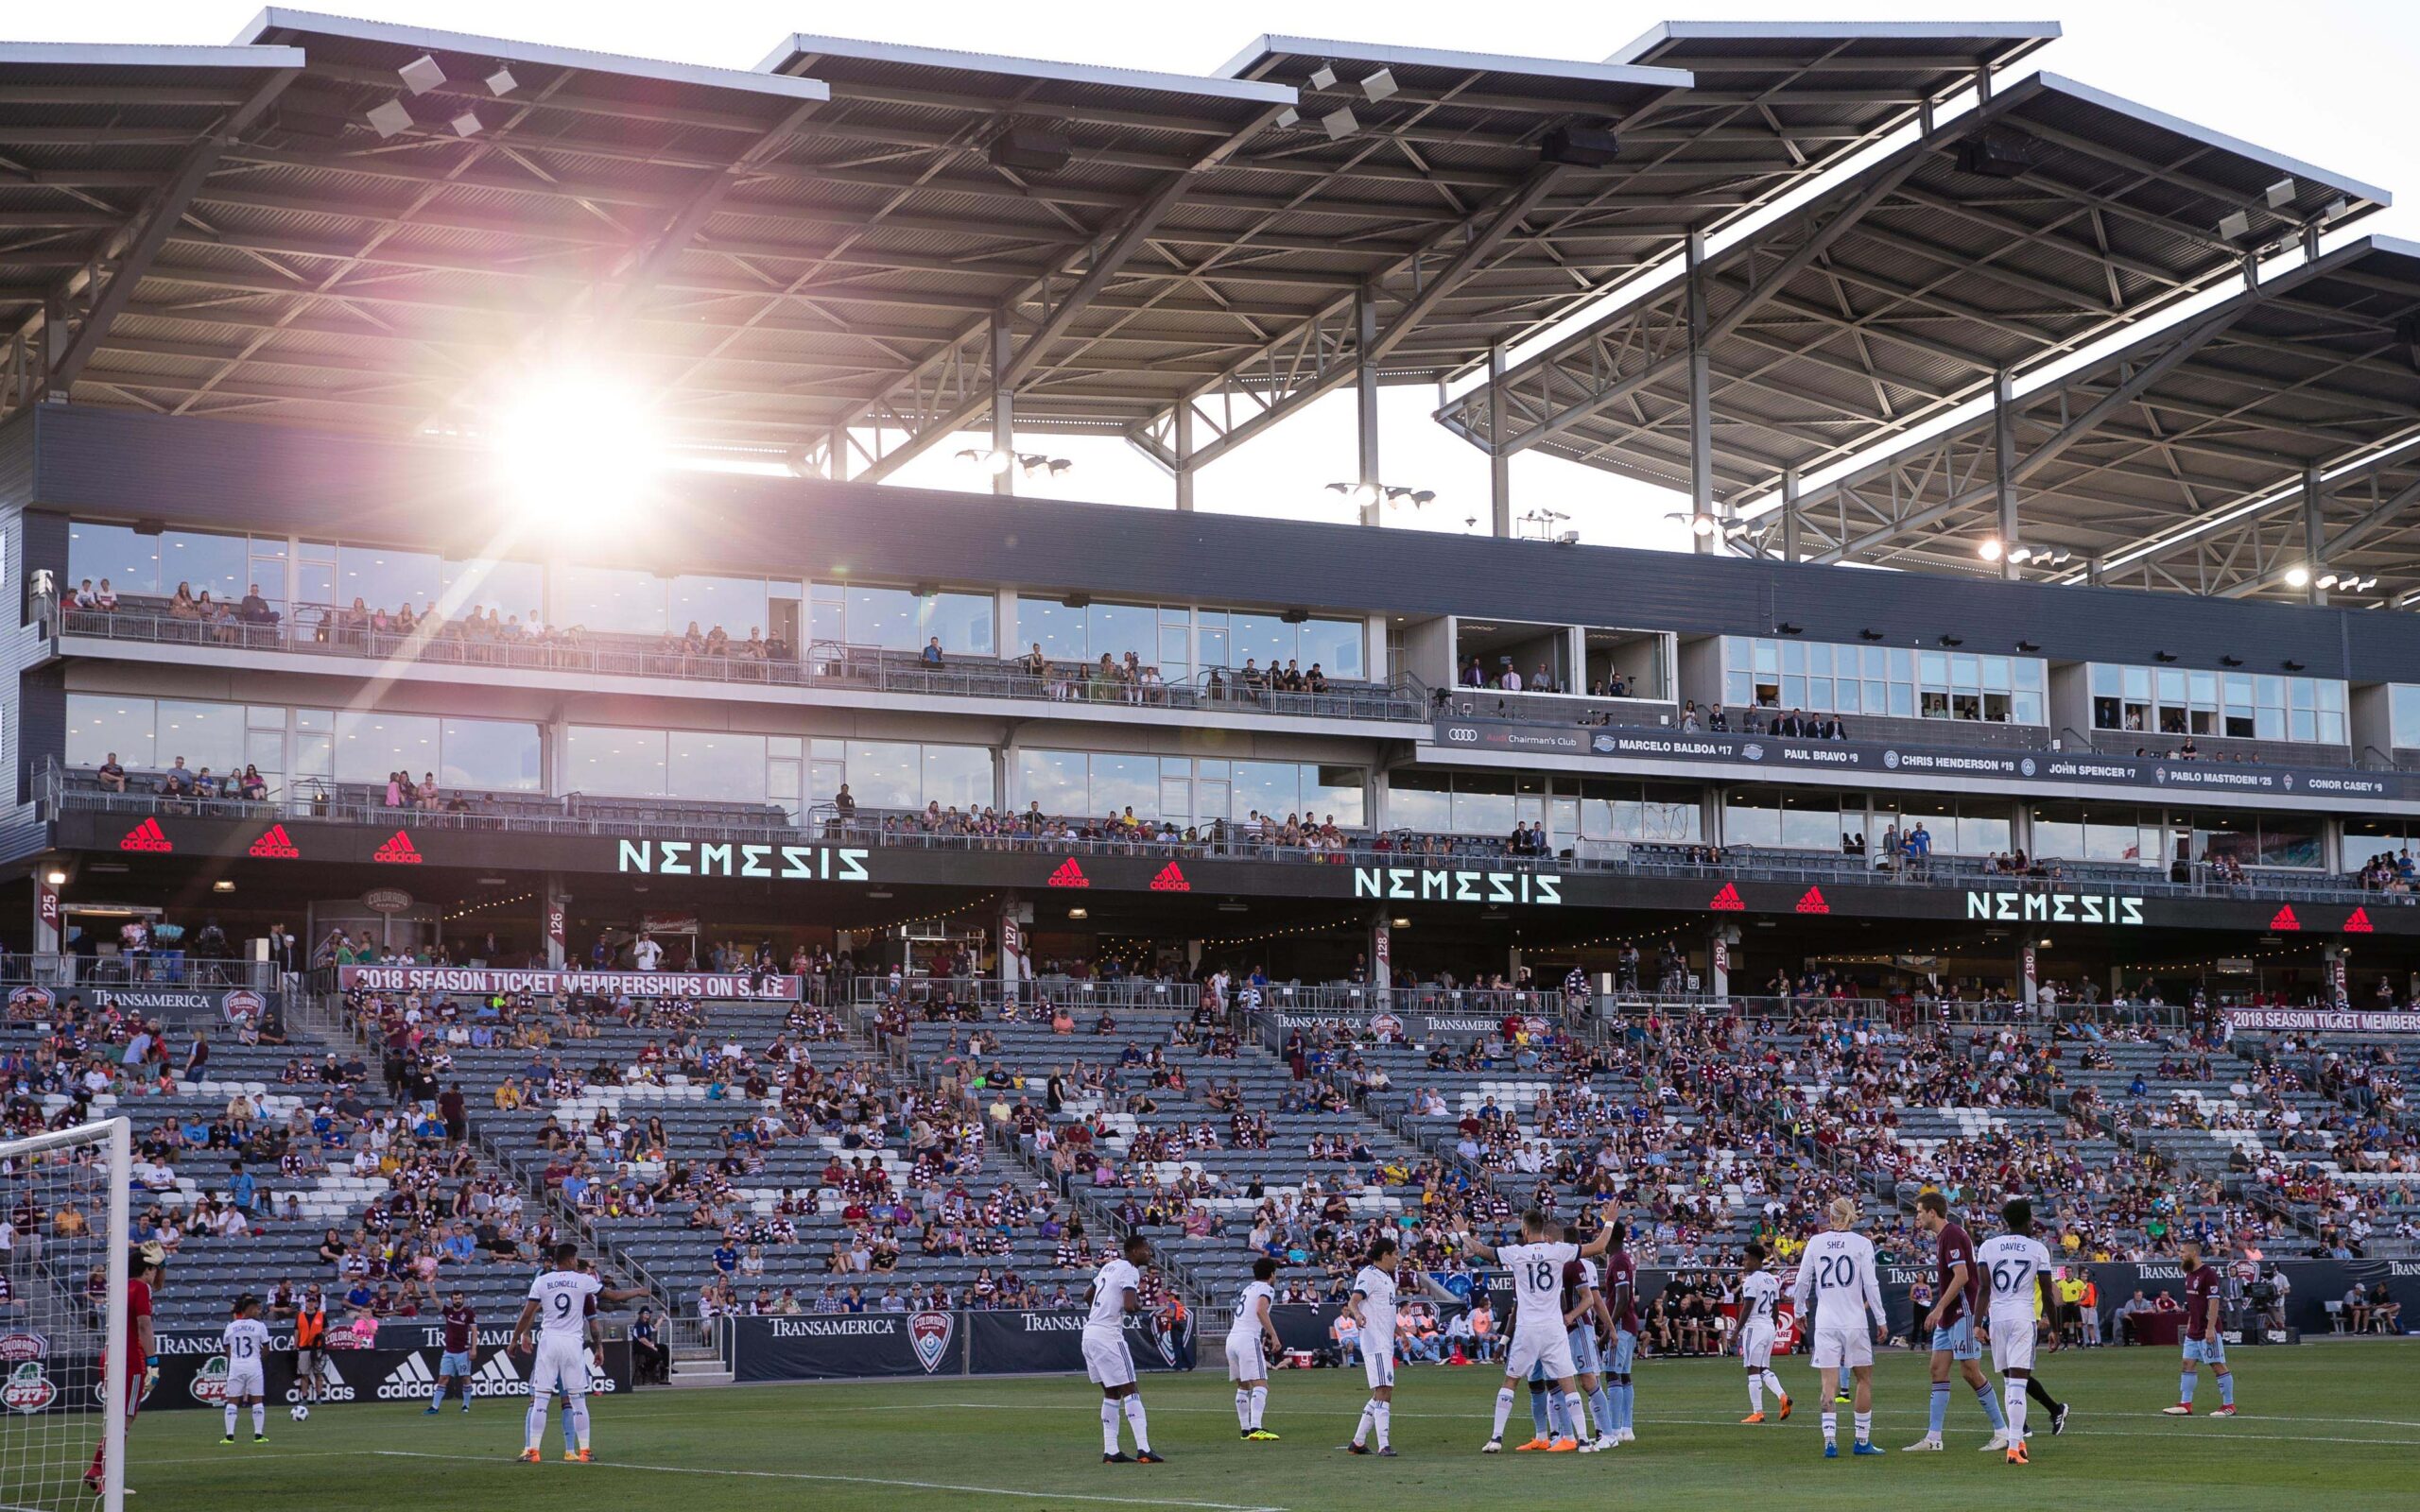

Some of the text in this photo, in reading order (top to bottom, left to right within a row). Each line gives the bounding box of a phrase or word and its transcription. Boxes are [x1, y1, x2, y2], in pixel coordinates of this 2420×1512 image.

[1486, 732, 1577, 747] Audi Chairman's Club
[1618, 739, 1733, 756] MARCELO BALBOA #17
[1785, 748, 1858, 763] PAUL BRAVO #9
[1902, 755, 2014, 771] CHRIS HENDERSON #19
[2048, 764, 2135, 779] JOHN SPENCER #7
[2170, 771, 2273, 786] PABLO MASTROENI #25
[2308, 779, 2383, 792] CONOR CASEY #9
[120, 838, 173, 852] adidas
[250, 845, 300, 858] adidas
[373, 851, 423, 864] adidas
[1047, 875, 1090, 887] adidas
[1150, 879, 1190, 892] adidas
[368, 891, 408, 906] COLORADO
[1710, 899, 1745, 911] adidas
[43, 894, 57, 919] 125
[1796, 902, 1830, 914] adidas
[550, 913, 563, 936] 126
[2270, 921, 2300, 931] adidas
[2343, 923, 2374, 933] adidas
[1005, 925, 1017, 946] 127
[1377, 936, 1388, 957] 128
[1716, 946, 1725, 966] 129
[2026, 955, 2035, 974] 130
[356, 969, 404, 990] 2018
[409, 971, 486, 991] SEASON
[491, 971, 557, 993] TICKET
[562, 975, 701, 996] MEMBERSHIPS
[707, 977, 733, 997] ON
[2337, 967, 2345, 984] 131
[93, 989, 211, 1008] TRANSAMERICA
[230, 997, 259, 1008] COLORADO
[1425, 1017, 1502, 1032] TRANSAMERIC
[2234, 1011, 2263, 1027] 2018
[2266, 1012, 2314, 1028] SEASON
[2317, 1013, 2359, 1030] TICKET
[1826, 1241, 1845, 1249] SHEA
[2000, 1244, 2027, 1252] DAVIES
[1526, 1262, 1553, 1294] 18
[1820, 1255, 1856, 1289] 20
[1992, 1259, 2031, 1294] 67
[546, 1281, 579, 1290] BLONDELL
[1094, 1278, 1106, 1308] 2
[554, 1293, 571, 1319] 9
[1757, 1290, 1776, 1314] 29
[769, 1317, 896, 1337] TRANSAMERICA
[914, 1315, 946, 1329] COLORADO
[235, 1336, 253, 1359] 13
[1953, 1340, 1966, 1354] 44
[1577, 1356, 1585, 1369] 5
